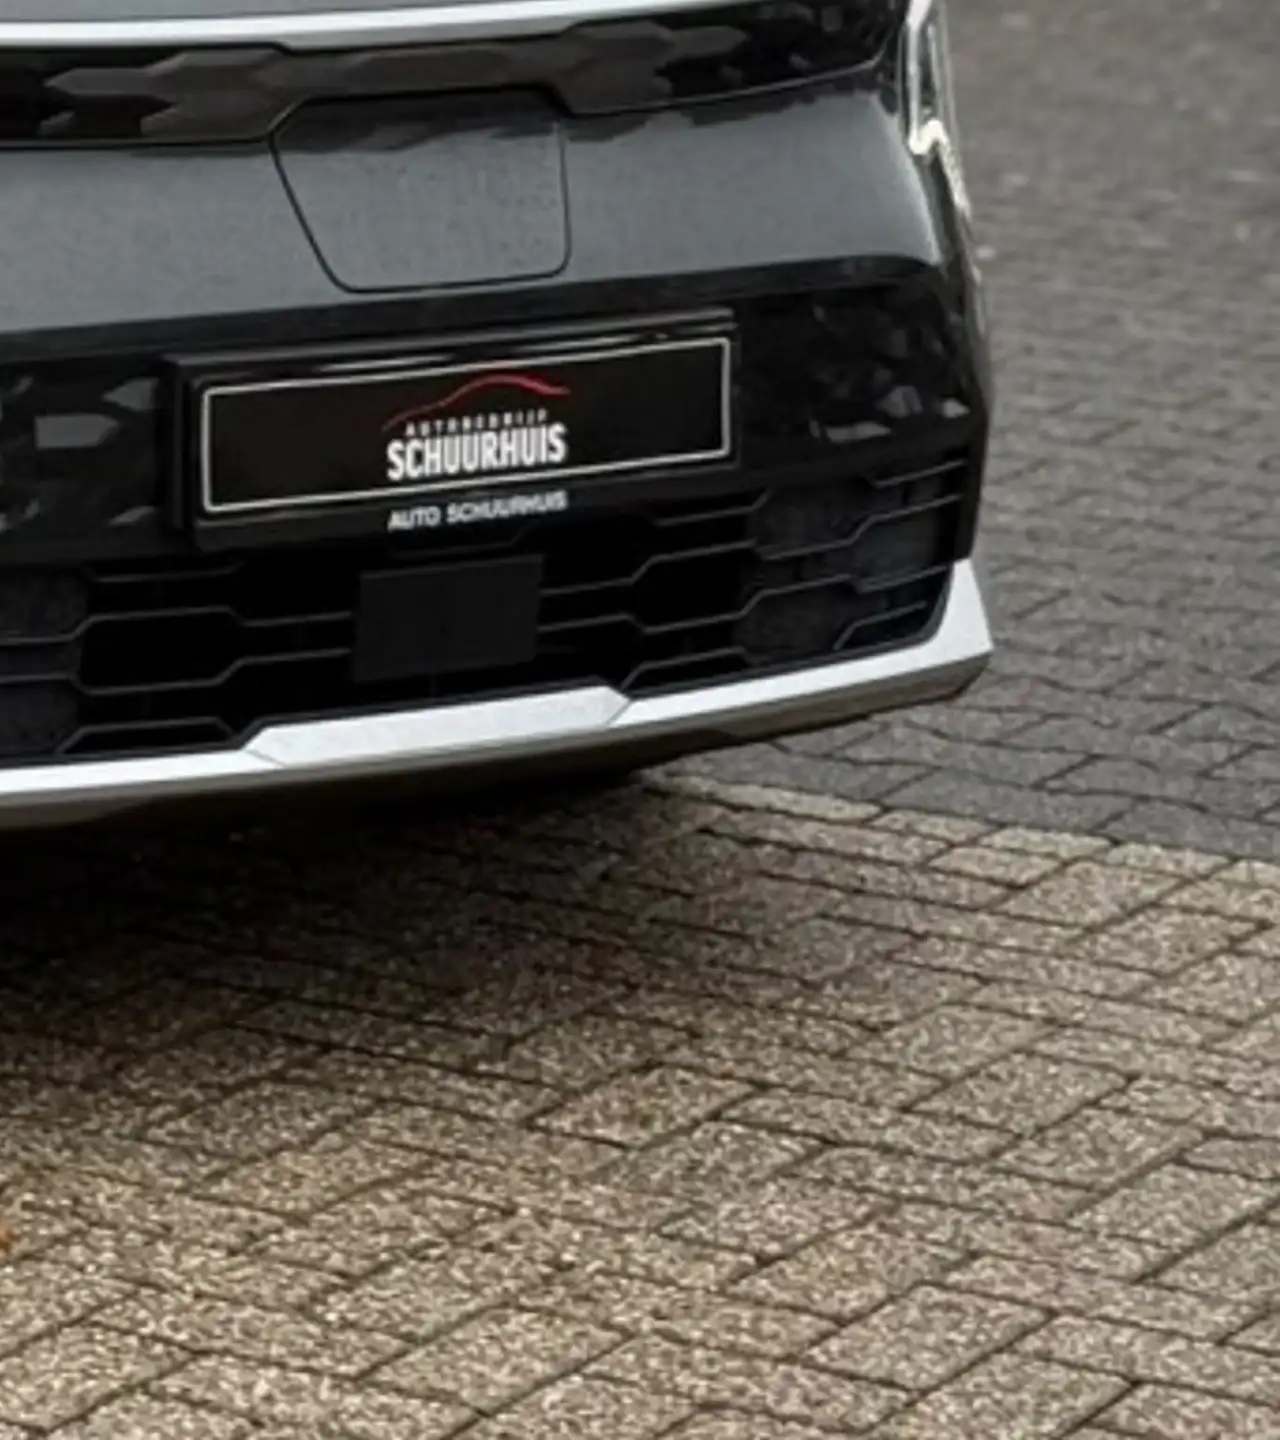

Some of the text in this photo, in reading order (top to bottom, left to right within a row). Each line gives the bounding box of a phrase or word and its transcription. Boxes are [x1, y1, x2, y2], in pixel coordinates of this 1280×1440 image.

[387, 421, 568, 482] SCHUURHUIS
[388, 489, 568, 531] AUTO SCHUURHUIS
